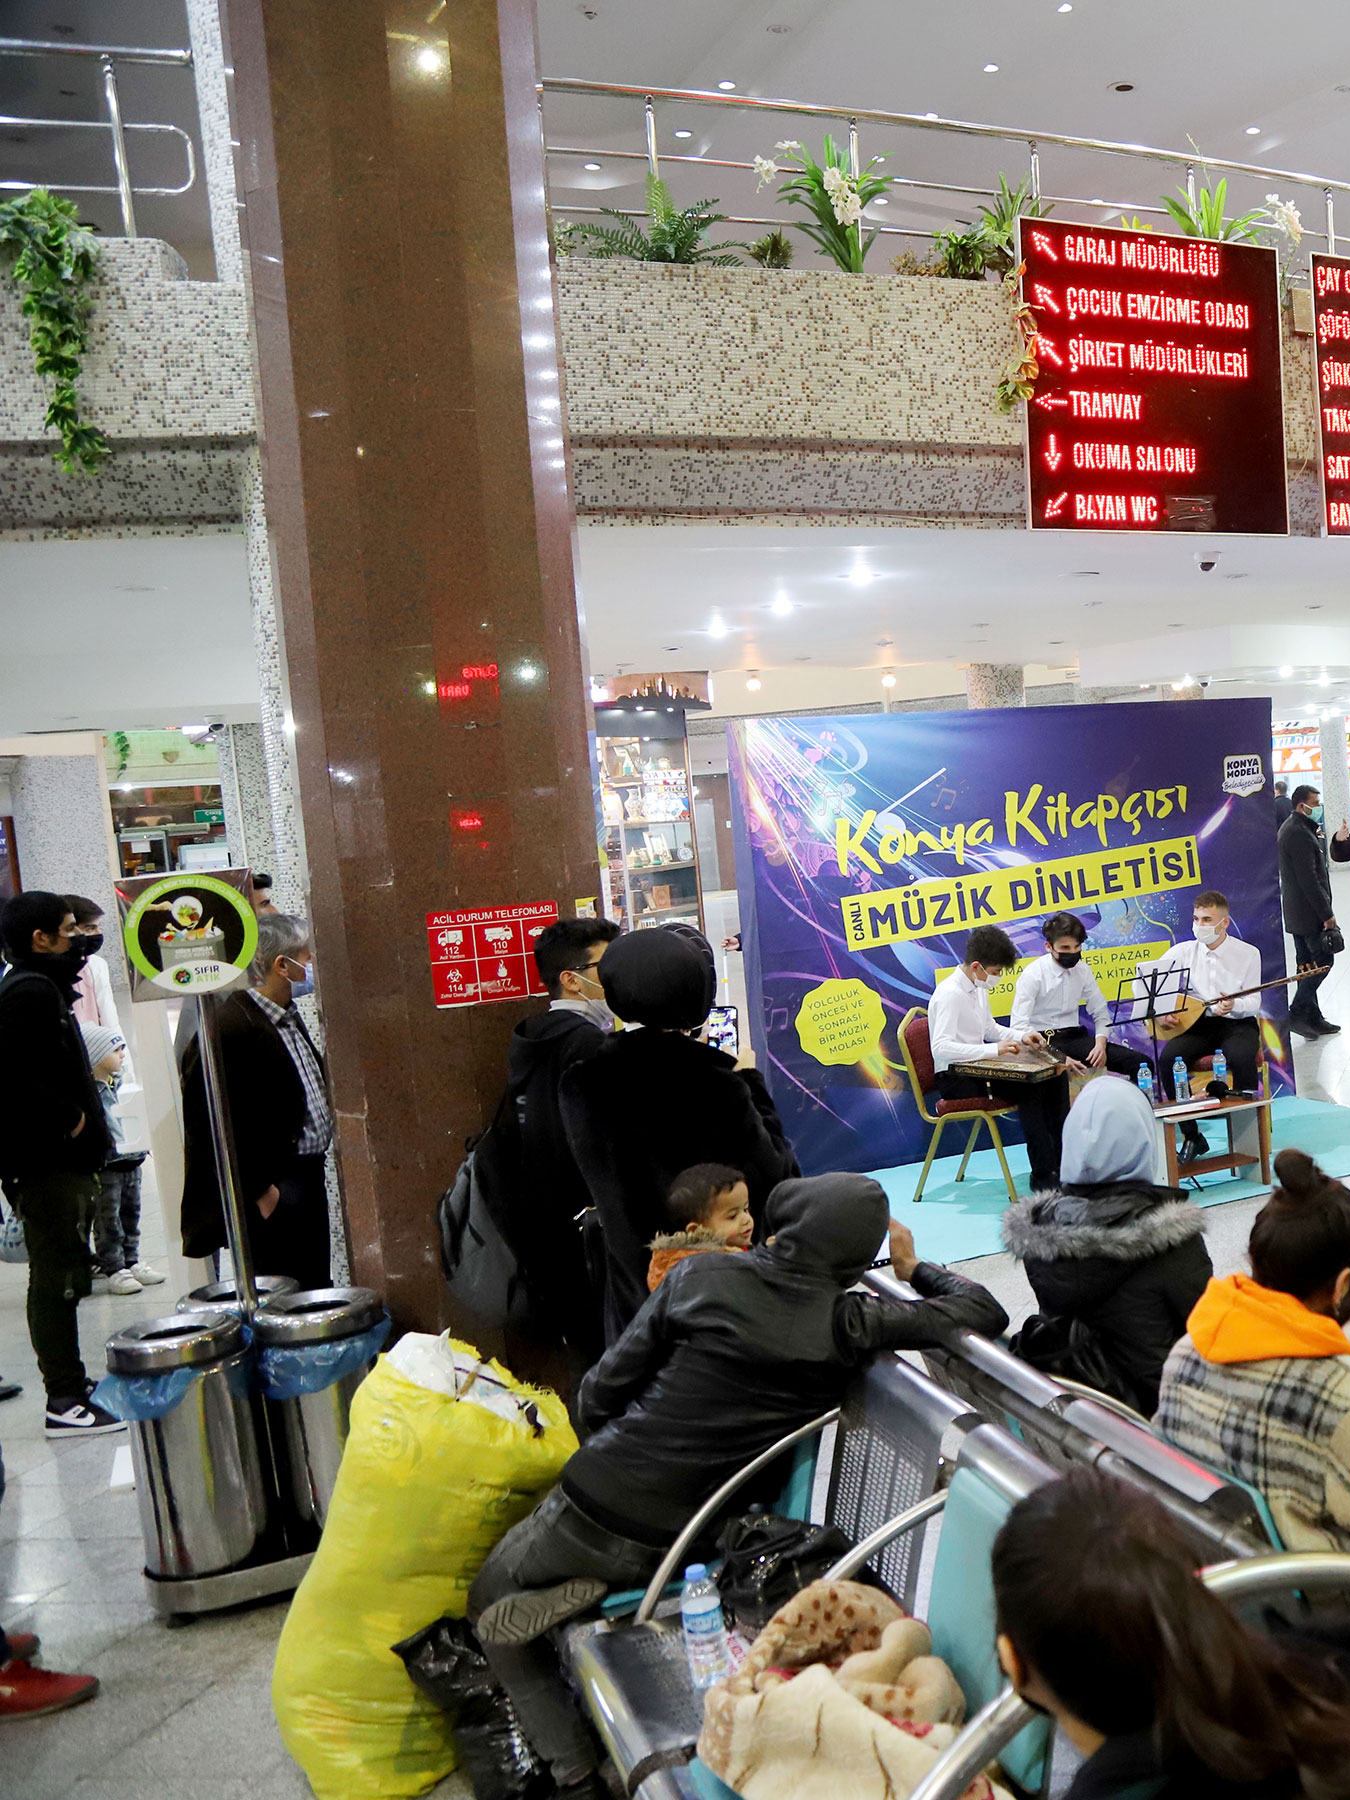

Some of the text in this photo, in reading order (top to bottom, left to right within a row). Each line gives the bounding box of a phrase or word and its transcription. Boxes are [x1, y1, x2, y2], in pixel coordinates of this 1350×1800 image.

[1064, 234, 1220, 277] GARAJ MÜDÜRLÜĞÜ
[1316, 265, 1340, 296] ÇAY
[1066, 286, 1249, 329] ÇOCUK EMZİRME ODASI
[1068, 333, 1249, 377] ŞİRKET MÜDÜRLÜKLERİ
[1069, 390, 1141, 420] TRAMVAY
[1073, 442, 1132, 471] OKUMA
[1075, 493, 1158, 521] BAYAN WC
[1226, 758, 1259, 770] KONYA
[1226, 767, 1260, 778] MODELİ
[835, 783, 1188, 876] Konya Kitapçısı
[867, 840, 1197, 939] MÜZİK DİNLETİSİ
[433, 904, 553, 925] ACİL DURUM TELEFONLARI
[848, 901, 865, 942] CANLI
[444, 946, 460, 955] 112
[492, 941, 508, 950] 110
[1111, 949, 1151, 963] PAZAR
[195, 965, 220, 975] SIFIR
[448, 984, 464, 992] 114
[496, 978, 512, 987] 177
[807, 989, 860, 1011] YOLCULUK
[851, 999, 865, 1009] VE
[818, 1013, 862, 1033] SONRASI
[829, 1036, 867, 1054] MOLASI
